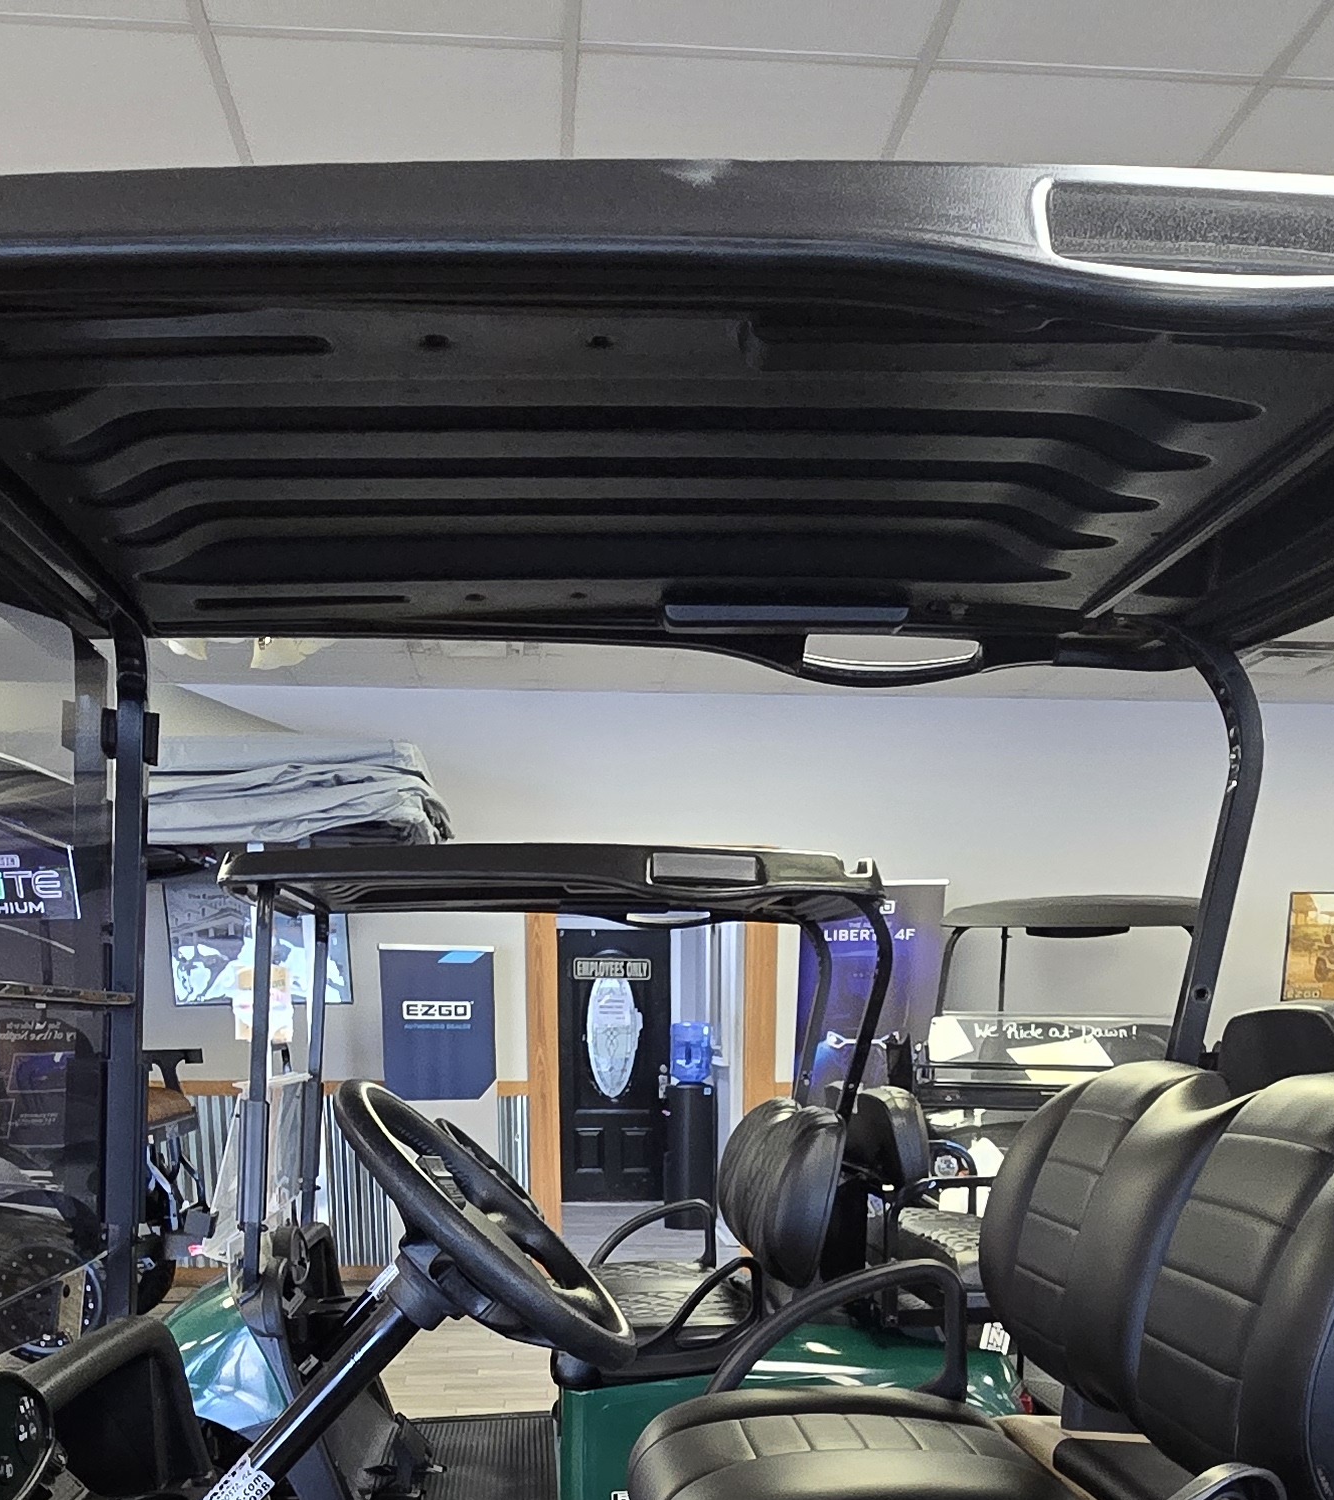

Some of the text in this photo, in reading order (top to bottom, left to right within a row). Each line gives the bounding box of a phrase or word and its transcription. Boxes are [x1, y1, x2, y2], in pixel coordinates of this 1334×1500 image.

[824, 929, 916, 942] LIBERT 4F
[576, 961, 648, 977] EMPLOYEES ONLY
[974, 1022, 1138, 1043] We Ride at Dawn!
